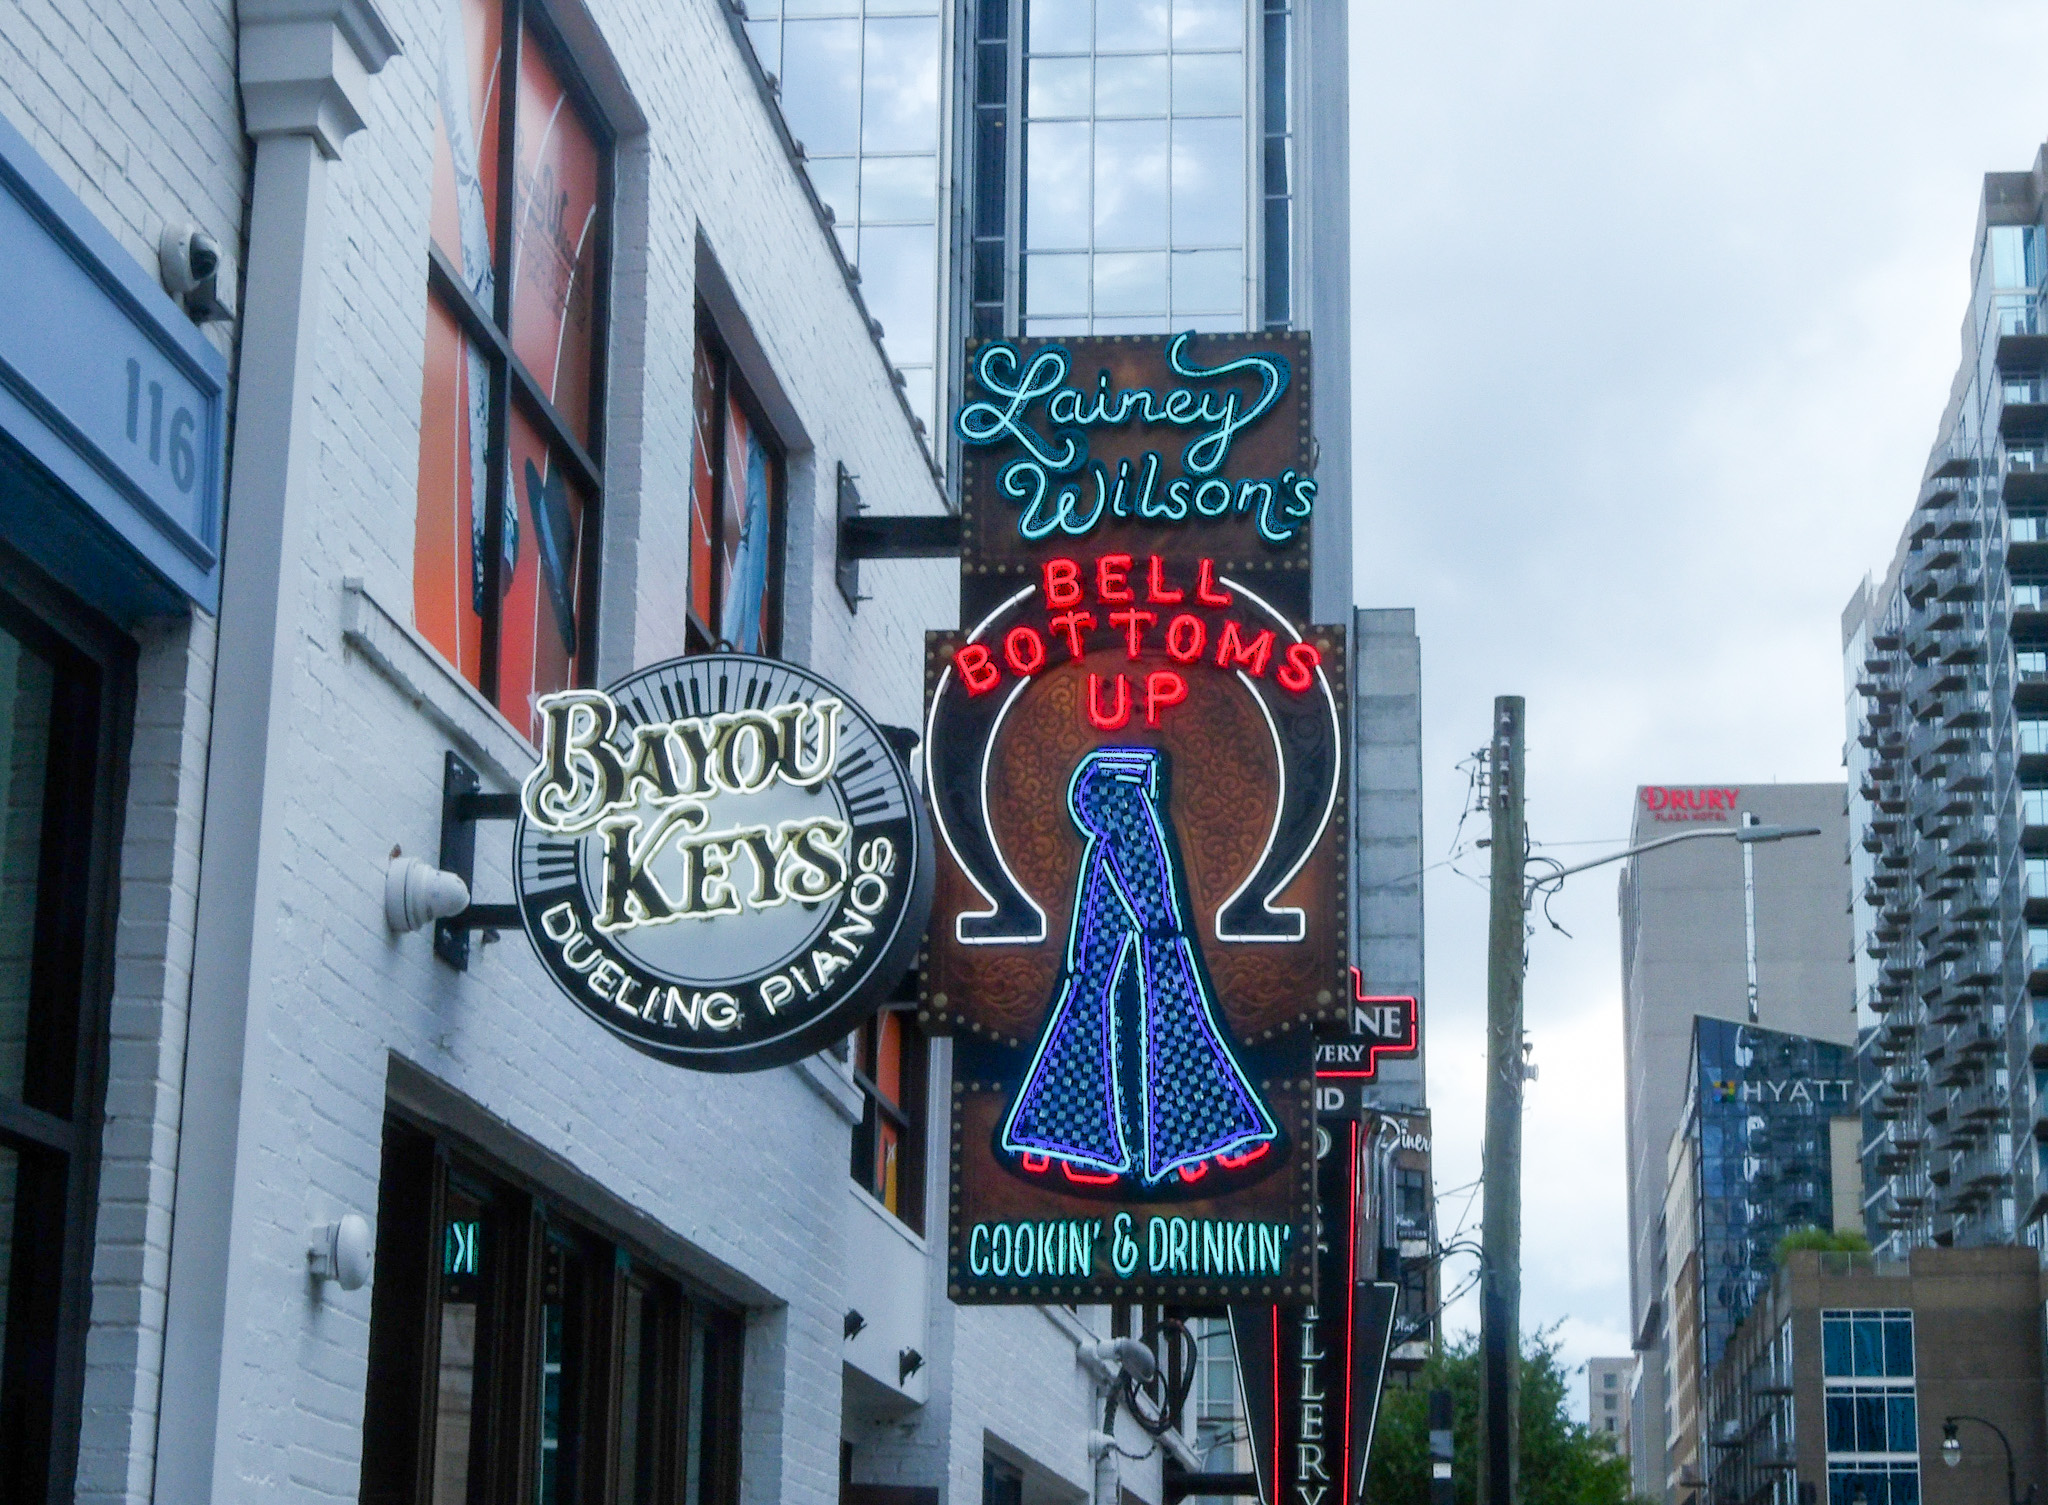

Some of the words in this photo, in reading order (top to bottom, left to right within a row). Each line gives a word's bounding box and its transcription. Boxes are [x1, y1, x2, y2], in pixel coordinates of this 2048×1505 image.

[125, 355, 197, 495] 116
[956, 332, 1290, 474] Lainey
[1000, 450, 1316, 541] Wilson's
[1042, 553, 1232, 608] BELL
[954, 607, 1322, 697] BOTTOMS
[1086, 670, 1188, 731] UP
[1640, 785, 1740, 811] DRURY
[592, 800, 852, 932] KEYS
[540, 901, 741, 1030] DUELING
[760, 835, 896, 1016] PIANOS
[1742, 1079, 1854, 1102] HYATT
[1380, 1114, 1431, 1153] Diner
[969, 1221, 1100, 1277] COOKIN'
[1112, 1212, 1139, 1275] &
[1149, 1216, 1290, 1276] DRINKIN'
